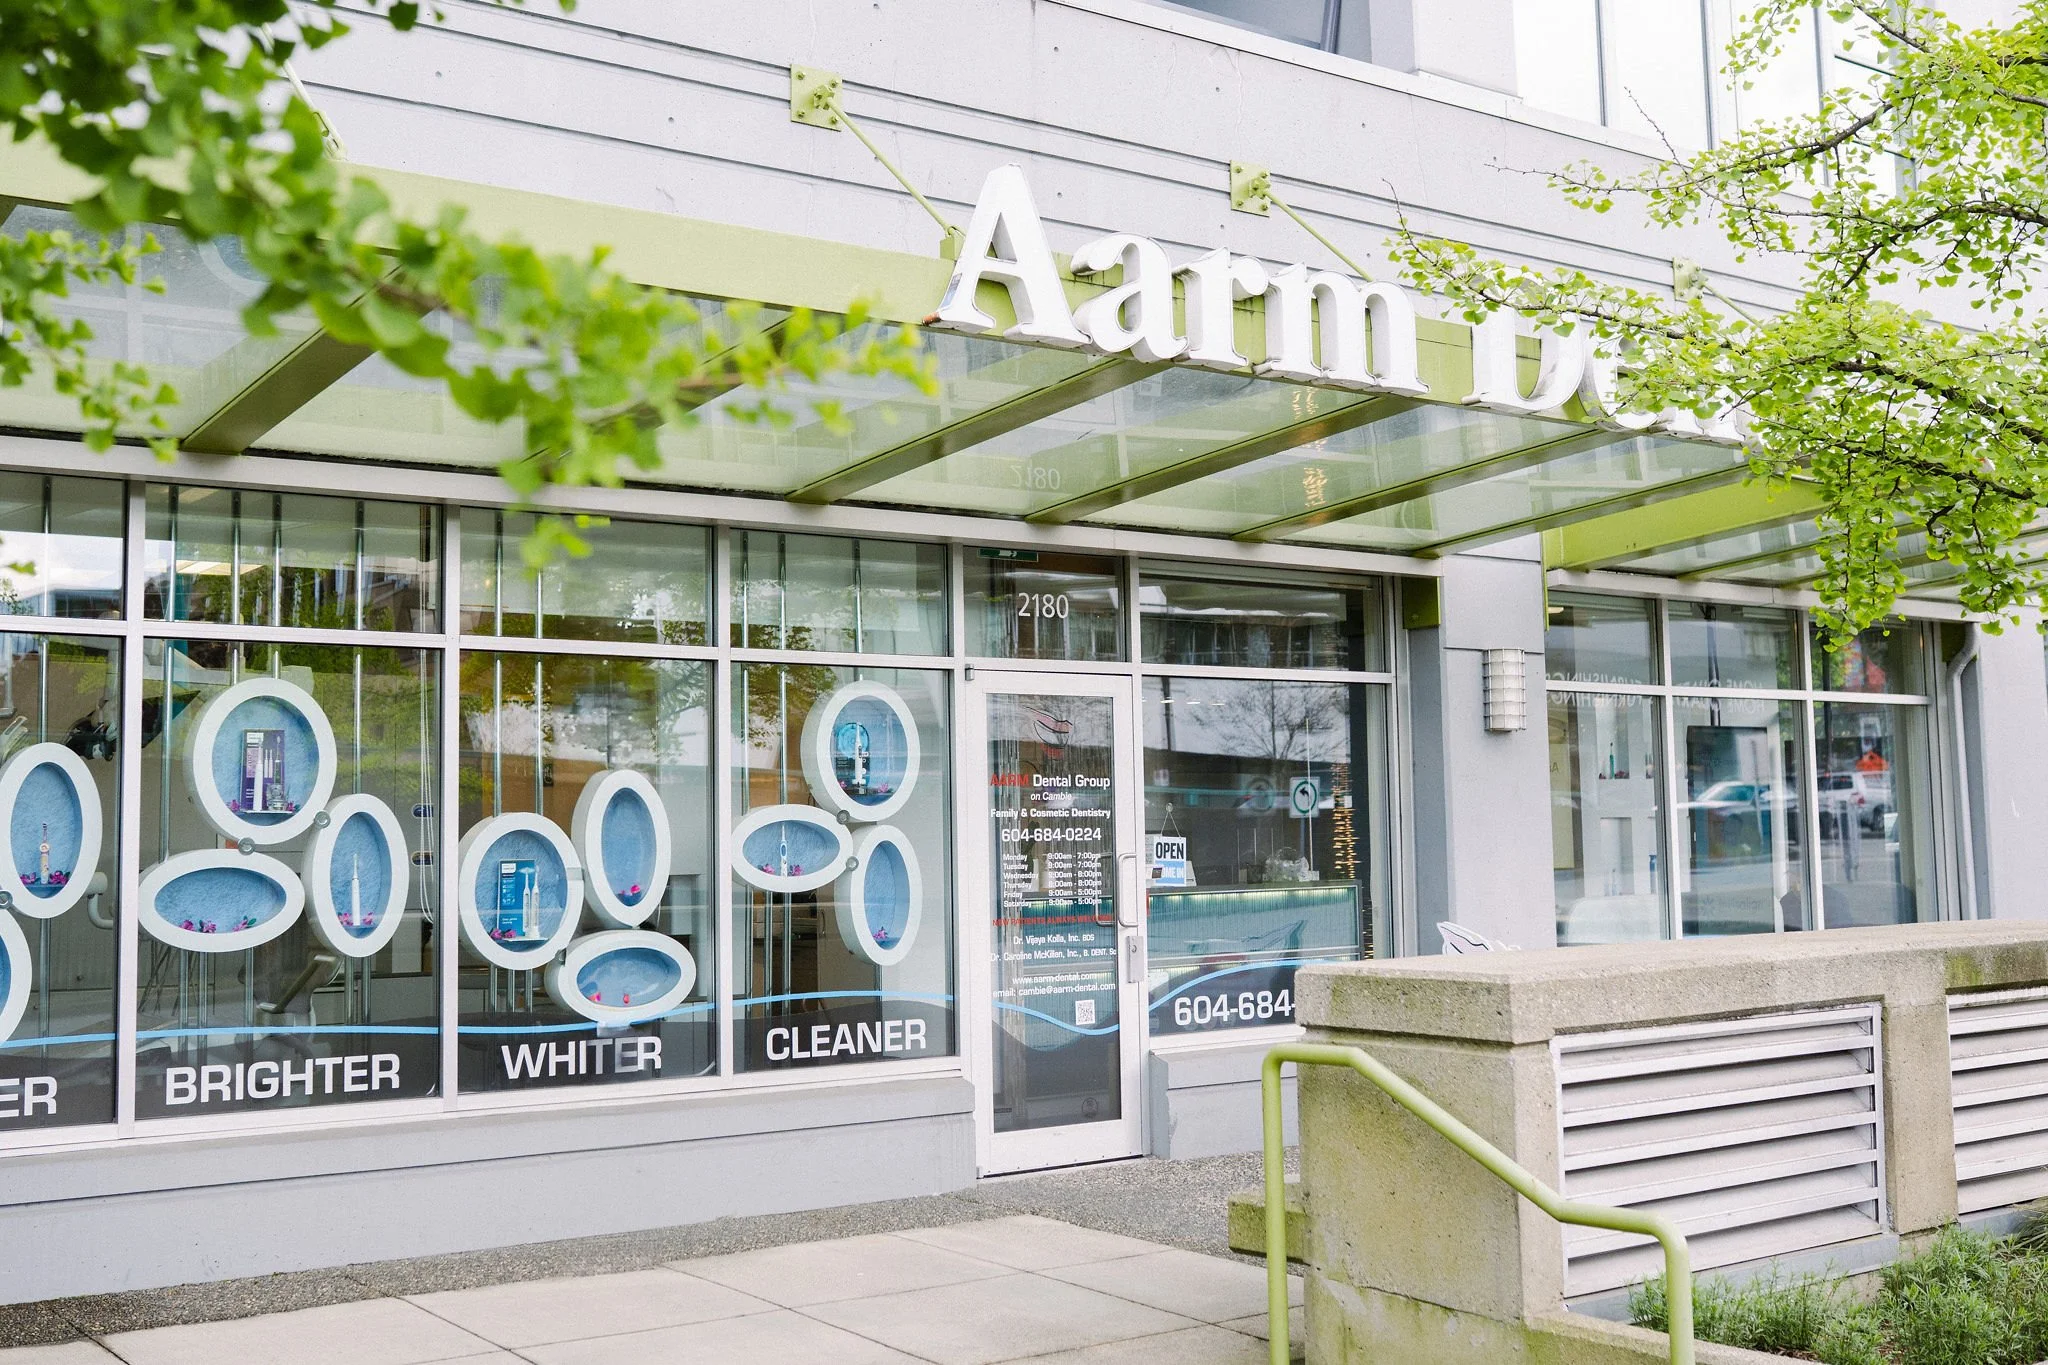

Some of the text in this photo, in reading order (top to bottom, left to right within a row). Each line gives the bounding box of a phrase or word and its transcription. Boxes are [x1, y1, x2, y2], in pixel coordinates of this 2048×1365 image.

[922, 162, 1430, 396] Aarm
[1018, 592, 1069, 619] 2180
[990, 774, 1111, 790] AARM Dental Group
[990, 808, 1111, 819] Family & Cosmetic Dentistry
[1001, 828, 1102, 842] 604-684-0224
[1003, 853, 1028, 862] Monday
[1155, 842, 1185, 860] OPEN
[1013, 937, 1024, 945] Dr.
[1068, 934, 1081, 942] Inc.
[766, 1018, 927, 1061] CLEANER
[501, 1036, 662, 1081] WHITER
[165, 1053, 400, 1106] BRIGHTER
